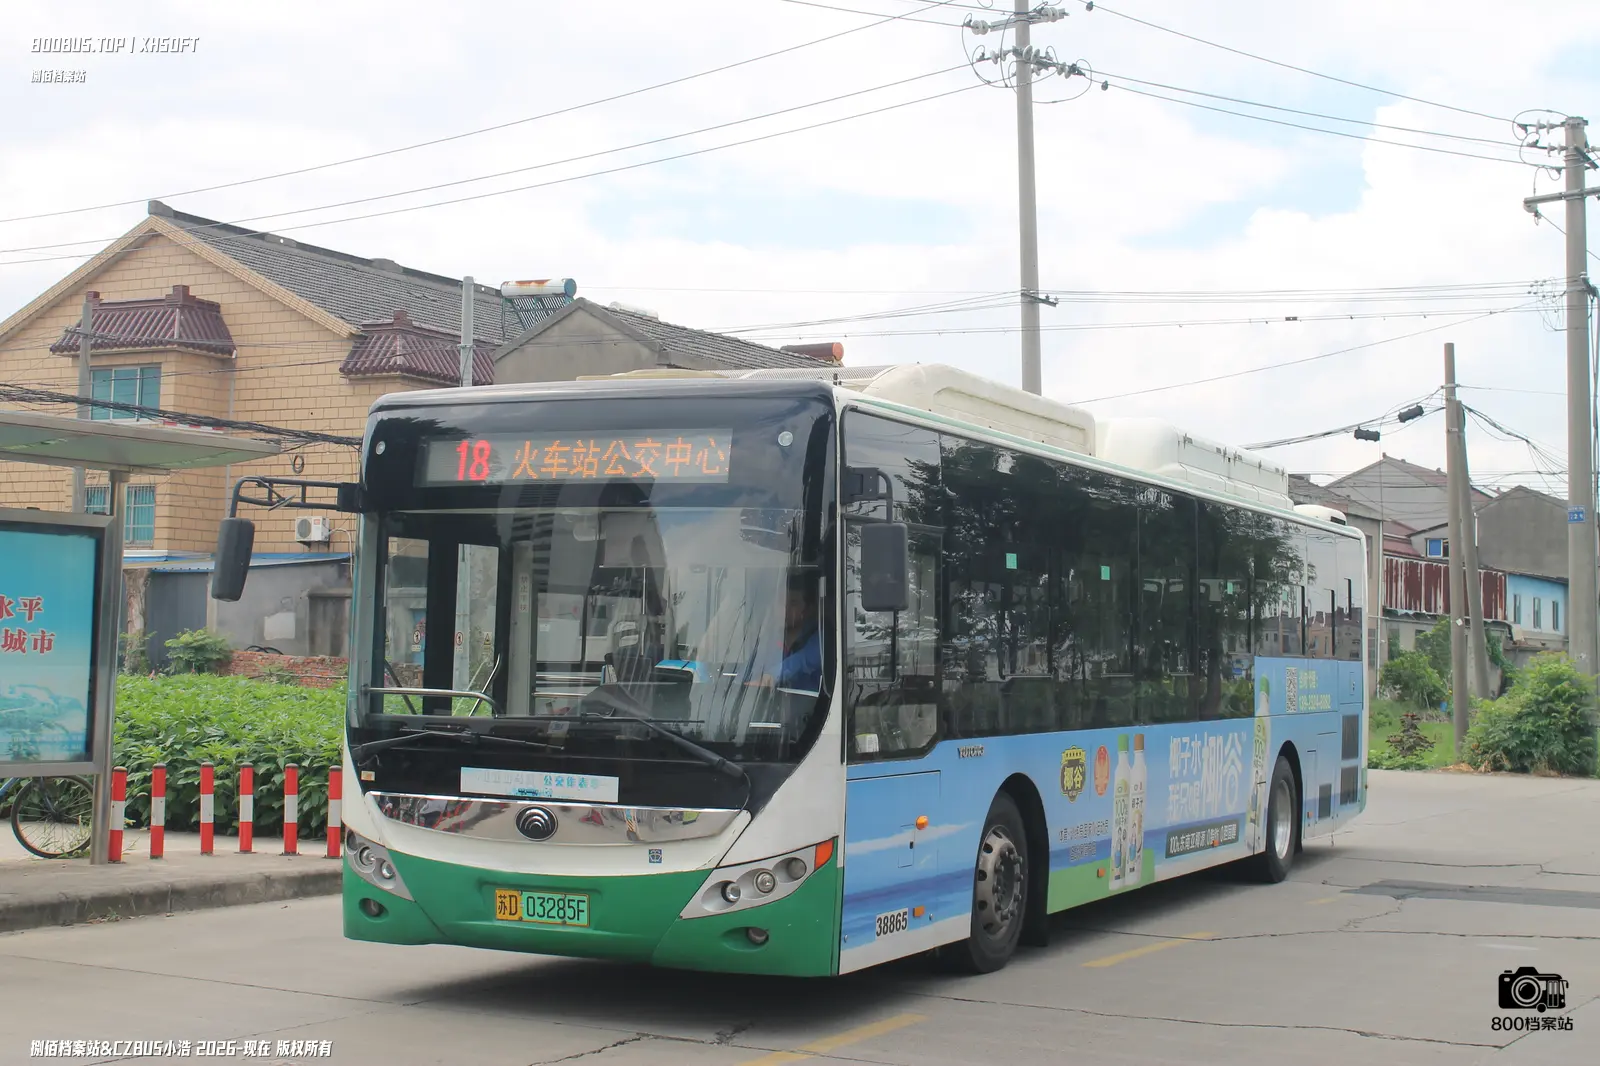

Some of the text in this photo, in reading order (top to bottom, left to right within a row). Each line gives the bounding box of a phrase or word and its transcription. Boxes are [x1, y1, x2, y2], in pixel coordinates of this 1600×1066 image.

[455, 435, 726, 482] 18 火车站公交中心
[0, 627, 56, 654] 城市
[497, 893, 586, 921] 苏D 03285F
[876, 911, 908, 937] 38865
